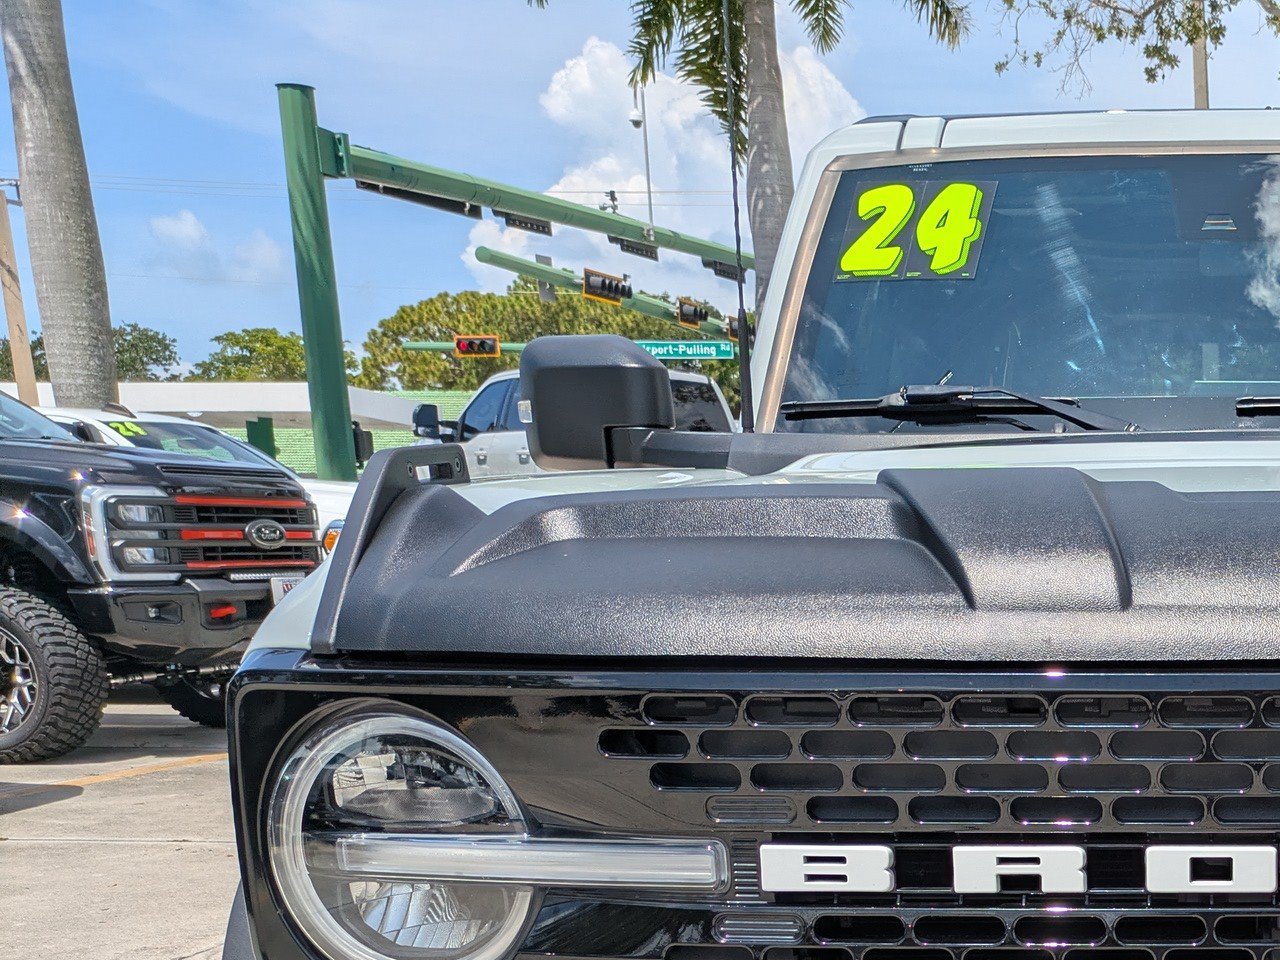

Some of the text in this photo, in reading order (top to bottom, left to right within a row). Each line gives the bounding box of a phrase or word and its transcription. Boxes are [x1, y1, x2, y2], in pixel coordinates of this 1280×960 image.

[840, 183, 983, 276] 24
[642, 344, 717, 356] rport-Pulling
[108, 421, 148, 437] 24
